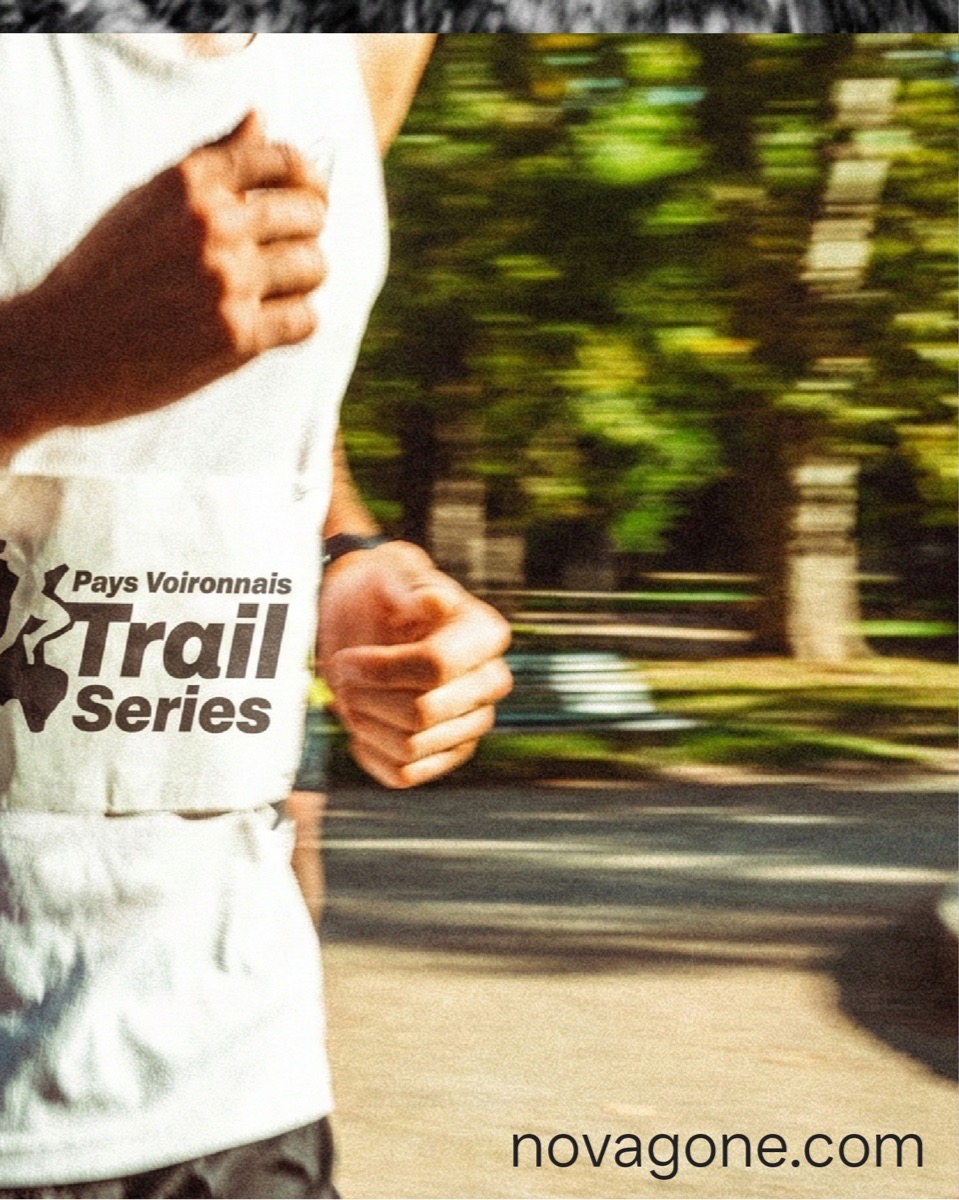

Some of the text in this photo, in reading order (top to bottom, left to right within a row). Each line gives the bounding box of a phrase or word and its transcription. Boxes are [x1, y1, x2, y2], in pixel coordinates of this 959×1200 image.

[72, 570, 293, 598] Pays Voironnais
[67, 601, 289, 679] Trail
[72, 684, 272, 734] Series
